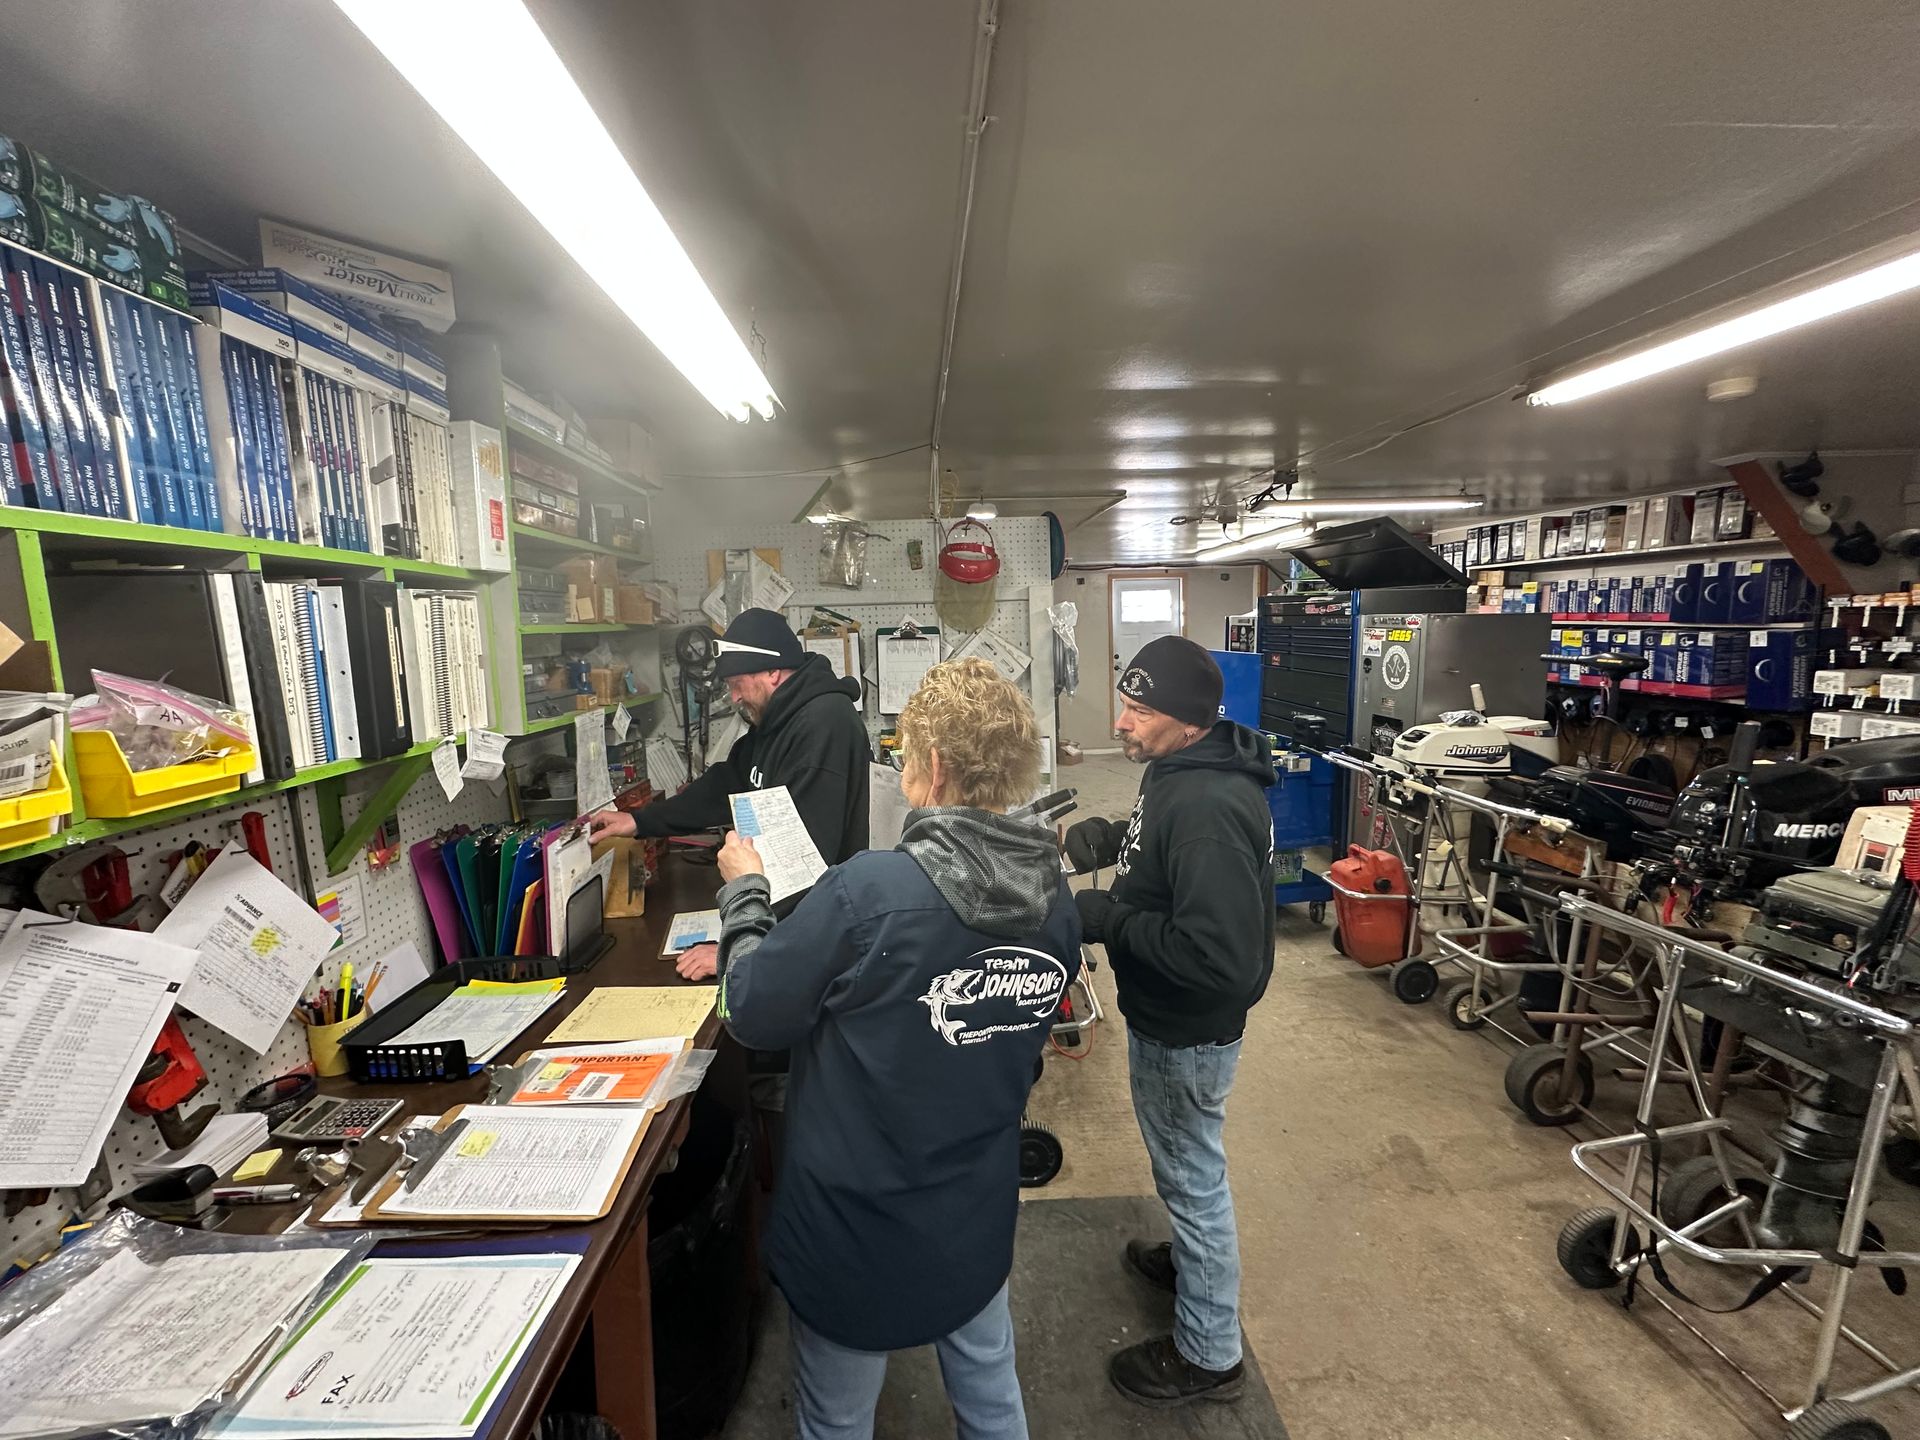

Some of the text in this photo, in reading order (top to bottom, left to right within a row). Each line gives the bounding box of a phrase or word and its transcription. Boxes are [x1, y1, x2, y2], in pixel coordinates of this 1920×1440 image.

[278, 337, 290, 348] 100
[1388, 629, 1413, 642] JEGS
[1792, 656, 1800, 698] EVINRUDE
[1799, 655, 1807, 698] Johnson
[159, 708, 184, 725] AA
[1445, 744, 1504, 757] Johnson
[238, 897, 264, 918] ADVANCE
[571, 1055, 651, 1064] IMPORTANT
[321, 1374, 355, 1404] FAX
